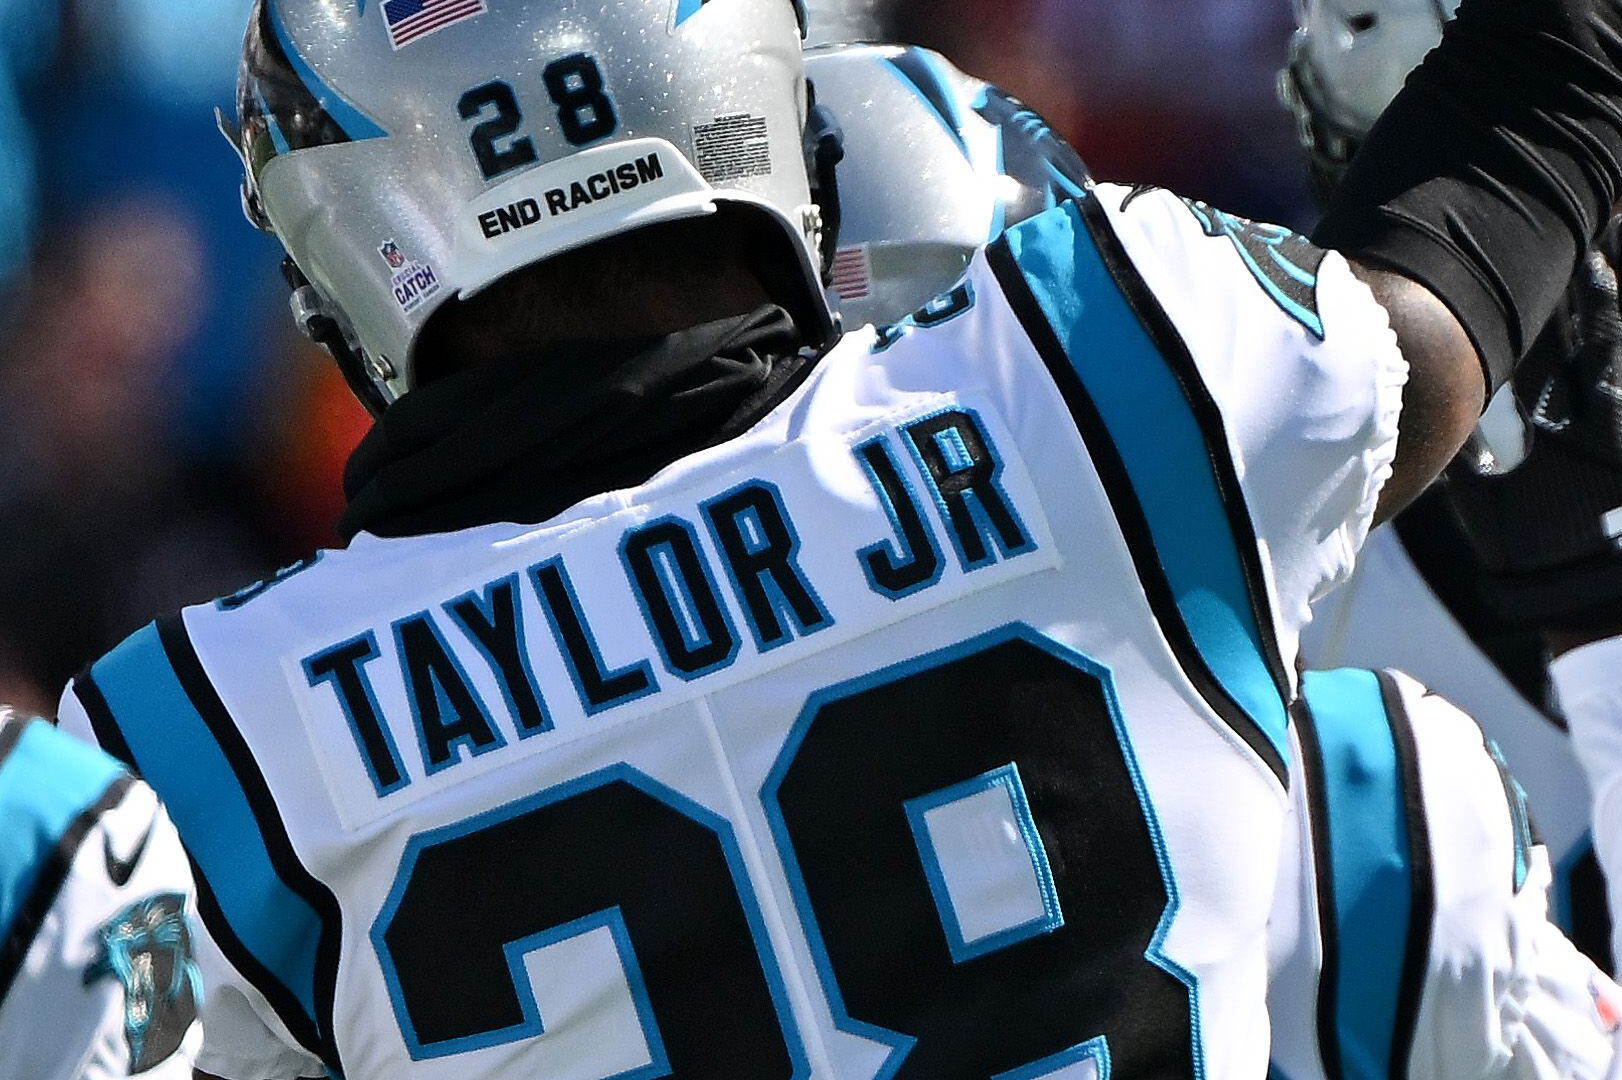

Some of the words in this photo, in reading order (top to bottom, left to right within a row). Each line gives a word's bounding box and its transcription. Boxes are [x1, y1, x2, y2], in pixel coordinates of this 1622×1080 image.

[456, 50, 620, 181] 28
[478, 198, 541, 239] END
[544, 152, 664, 216] RACISM
[394, 264, 437, 305] CATCH
[301, 478, 834, 799] TAYLOR
[850, 403, 1037, 602] JR
